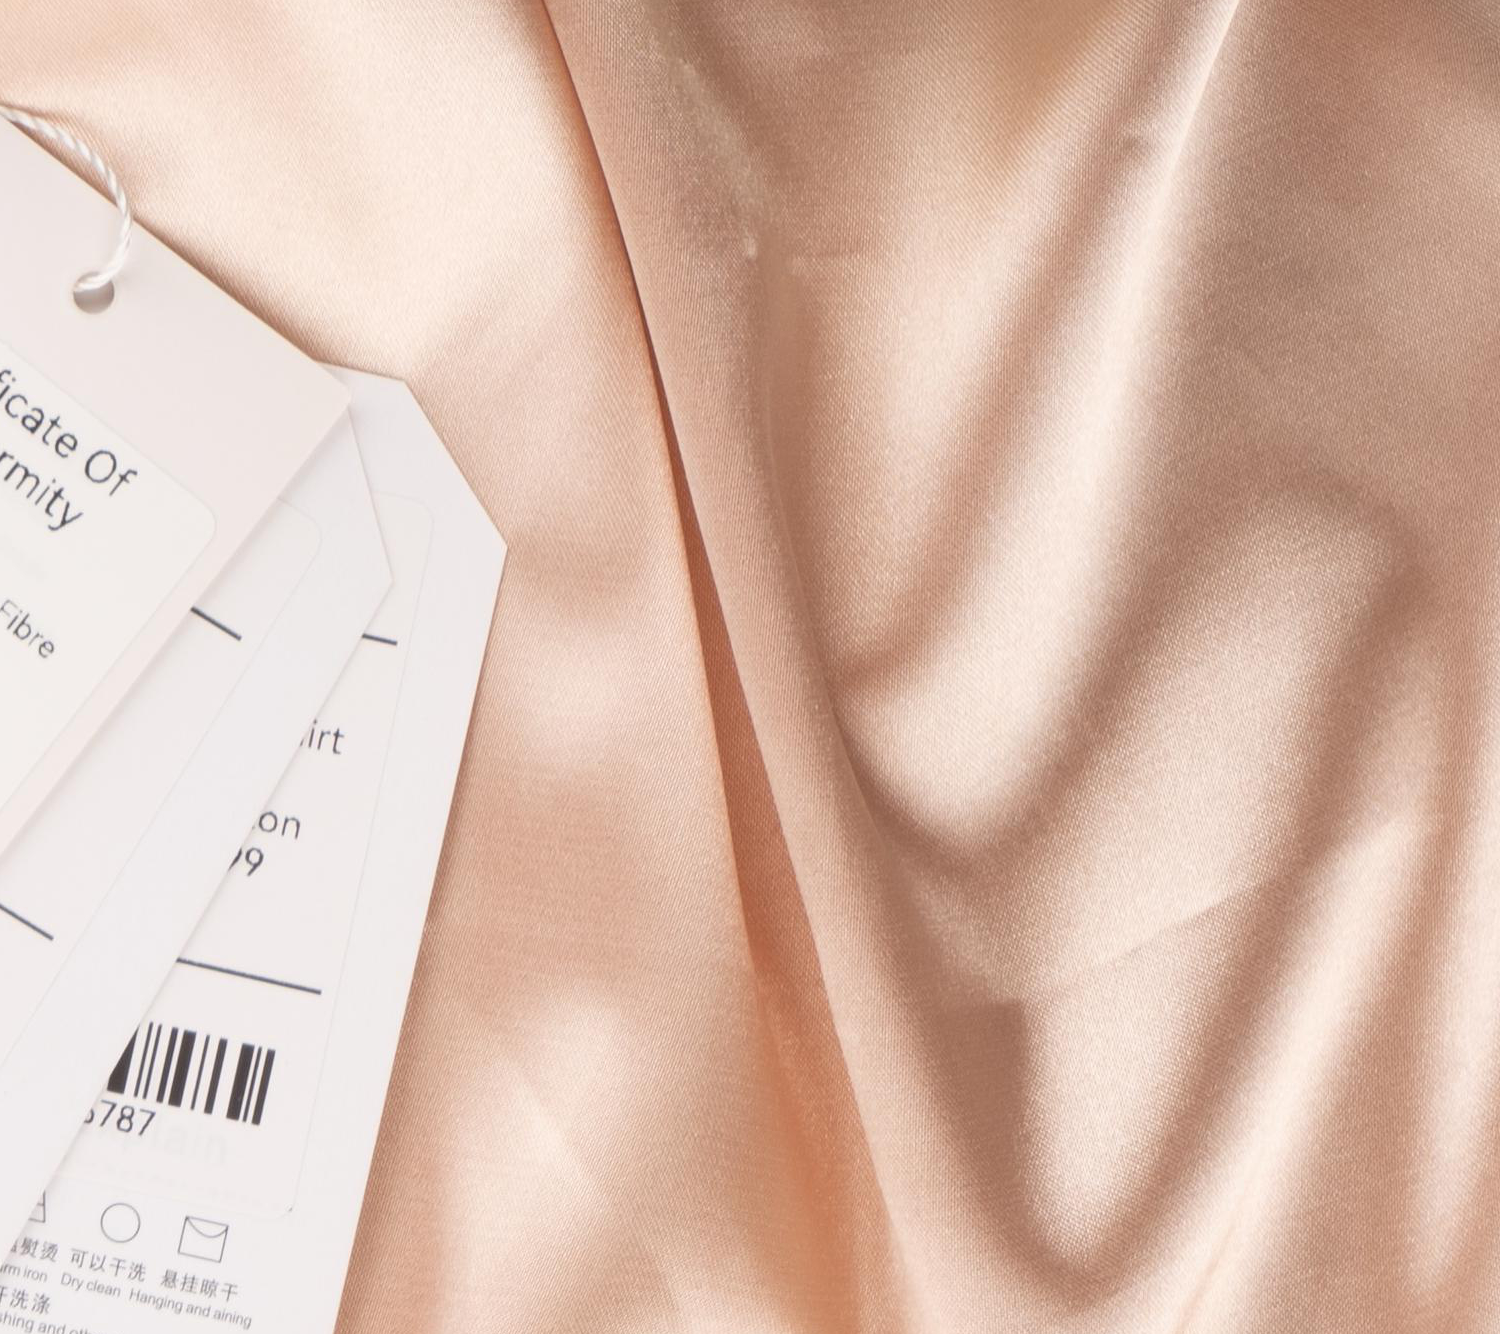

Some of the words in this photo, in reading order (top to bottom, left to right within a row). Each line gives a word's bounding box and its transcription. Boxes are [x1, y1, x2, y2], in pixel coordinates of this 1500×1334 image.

[84, 451, 137, 496] Of
[300, 719, 345, 755] irt
[252, 811, 301, 839] on
[71, 1247, 147, 1282] 可以干洗
[22, 1265, 48, 1283] iron
[61, 1272, 84, 1292] Dry
[86, 1279, 121, 1297] clean
[130, 1287, 183, 1315] Hanging
[185, 1299, 211, 1316] and
